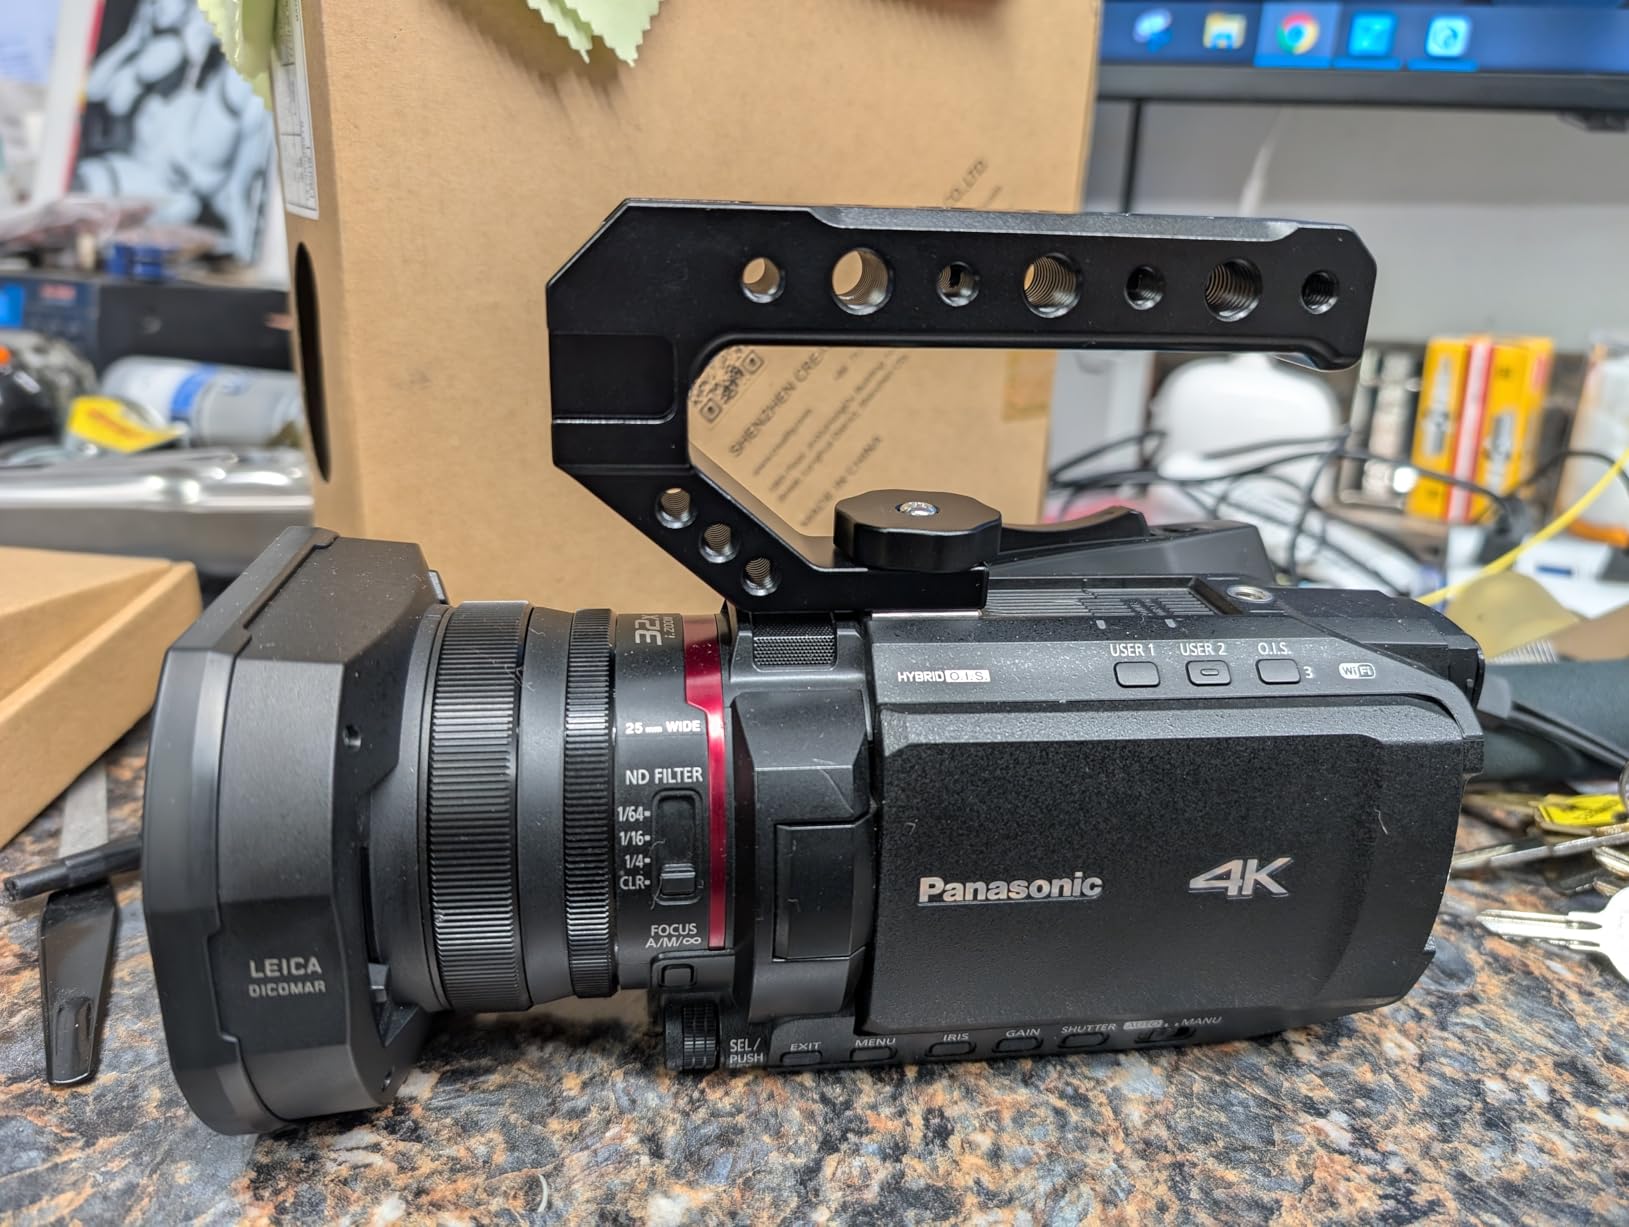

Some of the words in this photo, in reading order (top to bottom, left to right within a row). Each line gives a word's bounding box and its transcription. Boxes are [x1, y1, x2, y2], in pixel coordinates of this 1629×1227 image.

[729, 379, 797, 458] SHENZHEN
[1110, 643, 1145, 657] USER
[1149, 643, 1156, 656] 1
[1180, 643, 1214, 656] USER
[1217, 642, 1227, 656] 2
[1257, 642, 1292, 656] O.I.S.
[897, 670, 945, 683] HYBRID
[948, 670, 989, 682] O.I.S.
[1303, 665, 1314, 679] 3
[625, 722, 644, 735] 25
[665, 719, 701, 733] WIDE
[625, 769, 650, 786] ND
[654, 767, 703, 785] FILTER
[617, 805, 645, 823] 1/64
[619, 830, 645, 846] 1/16
[624, 854, 644, 869] 1/4
[619, 875, 645, 890] CLR
[1188, 856, 1294, 897] 4K
[918, 871, 1103, 904] Panasonic
[650, 922, 698, 937] FOCUS
[249, 956, 323, 979] LEICA
[248, 980, 327, 998] DICOMAR
[1060, 1022, 1117, 1034] SHUTTER
[1181, 1016, 1222, 1026] MANU
[943, 1032, 969, 1042] IRIS
[1005, 1028, 1041, 1038] GAIN
[729, 1038, 761, 1053] SEL/
[790, 1041, 822, 1052] EXIT
[855, 1037, 896, 1048] MENU
[729, 1052, 765, 1064] PUSH
